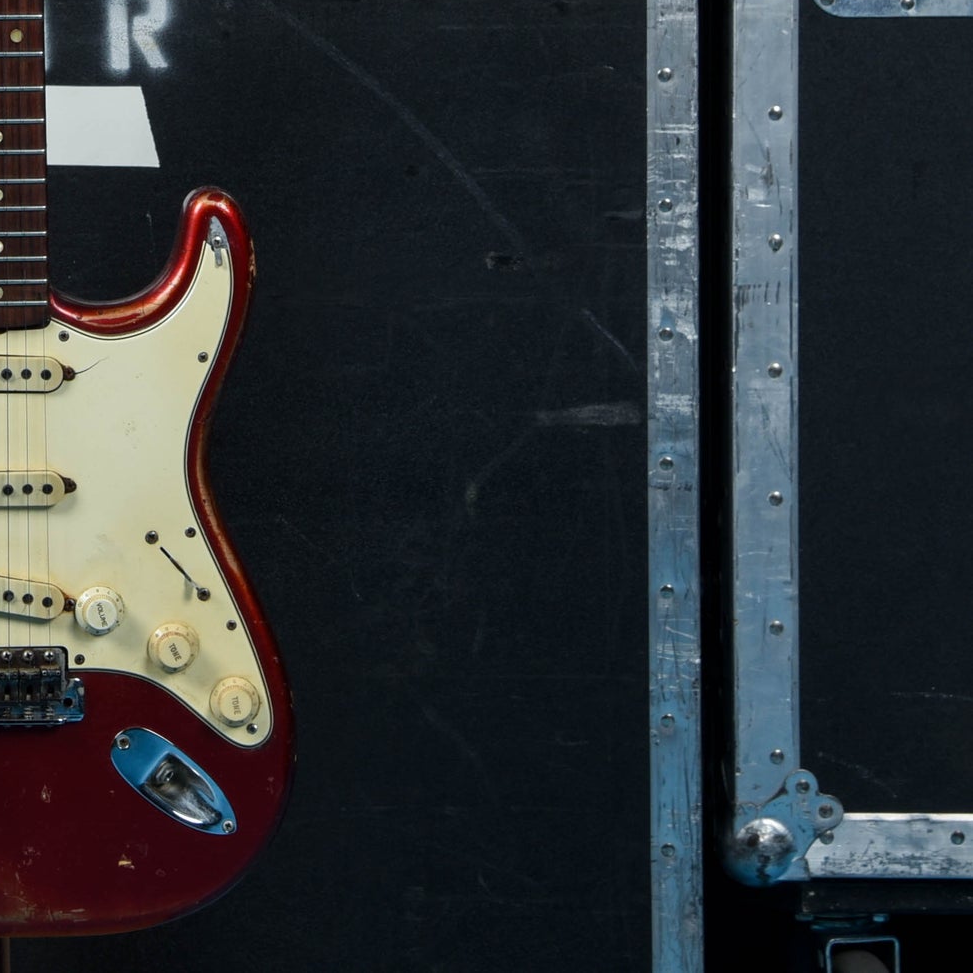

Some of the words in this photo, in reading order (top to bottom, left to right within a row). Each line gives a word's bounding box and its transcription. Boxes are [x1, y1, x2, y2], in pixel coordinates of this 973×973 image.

[95, 602, 109, 627] VOLUME
[168, 642, 182, 662] TONE
[231, 695, 242, 716] TONE
